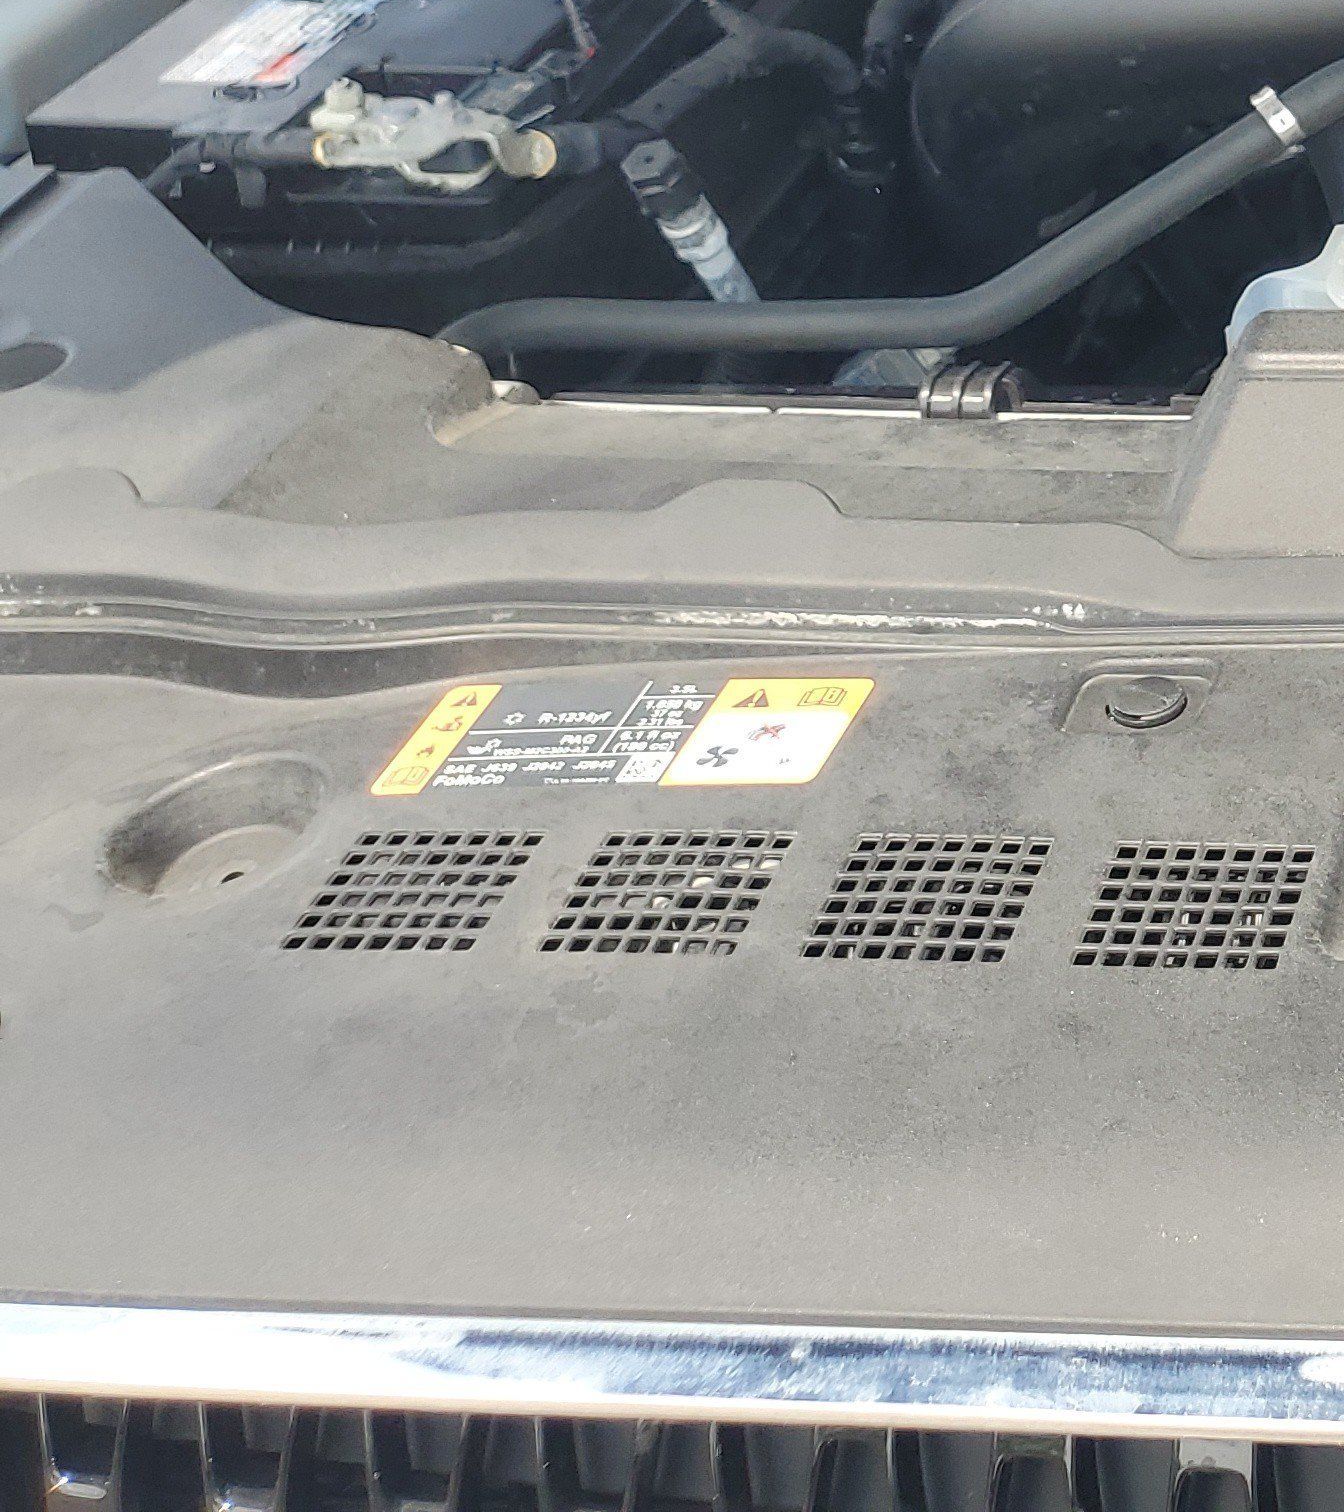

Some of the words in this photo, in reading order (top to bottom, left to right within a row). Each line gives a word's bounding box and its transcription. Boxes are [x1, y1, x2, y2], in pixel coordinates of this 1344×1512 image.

[559, 733, 598, 745] PAG
[443, 763, 477, 775] SAE
[433, 772, 506, 788] FoMoCo
